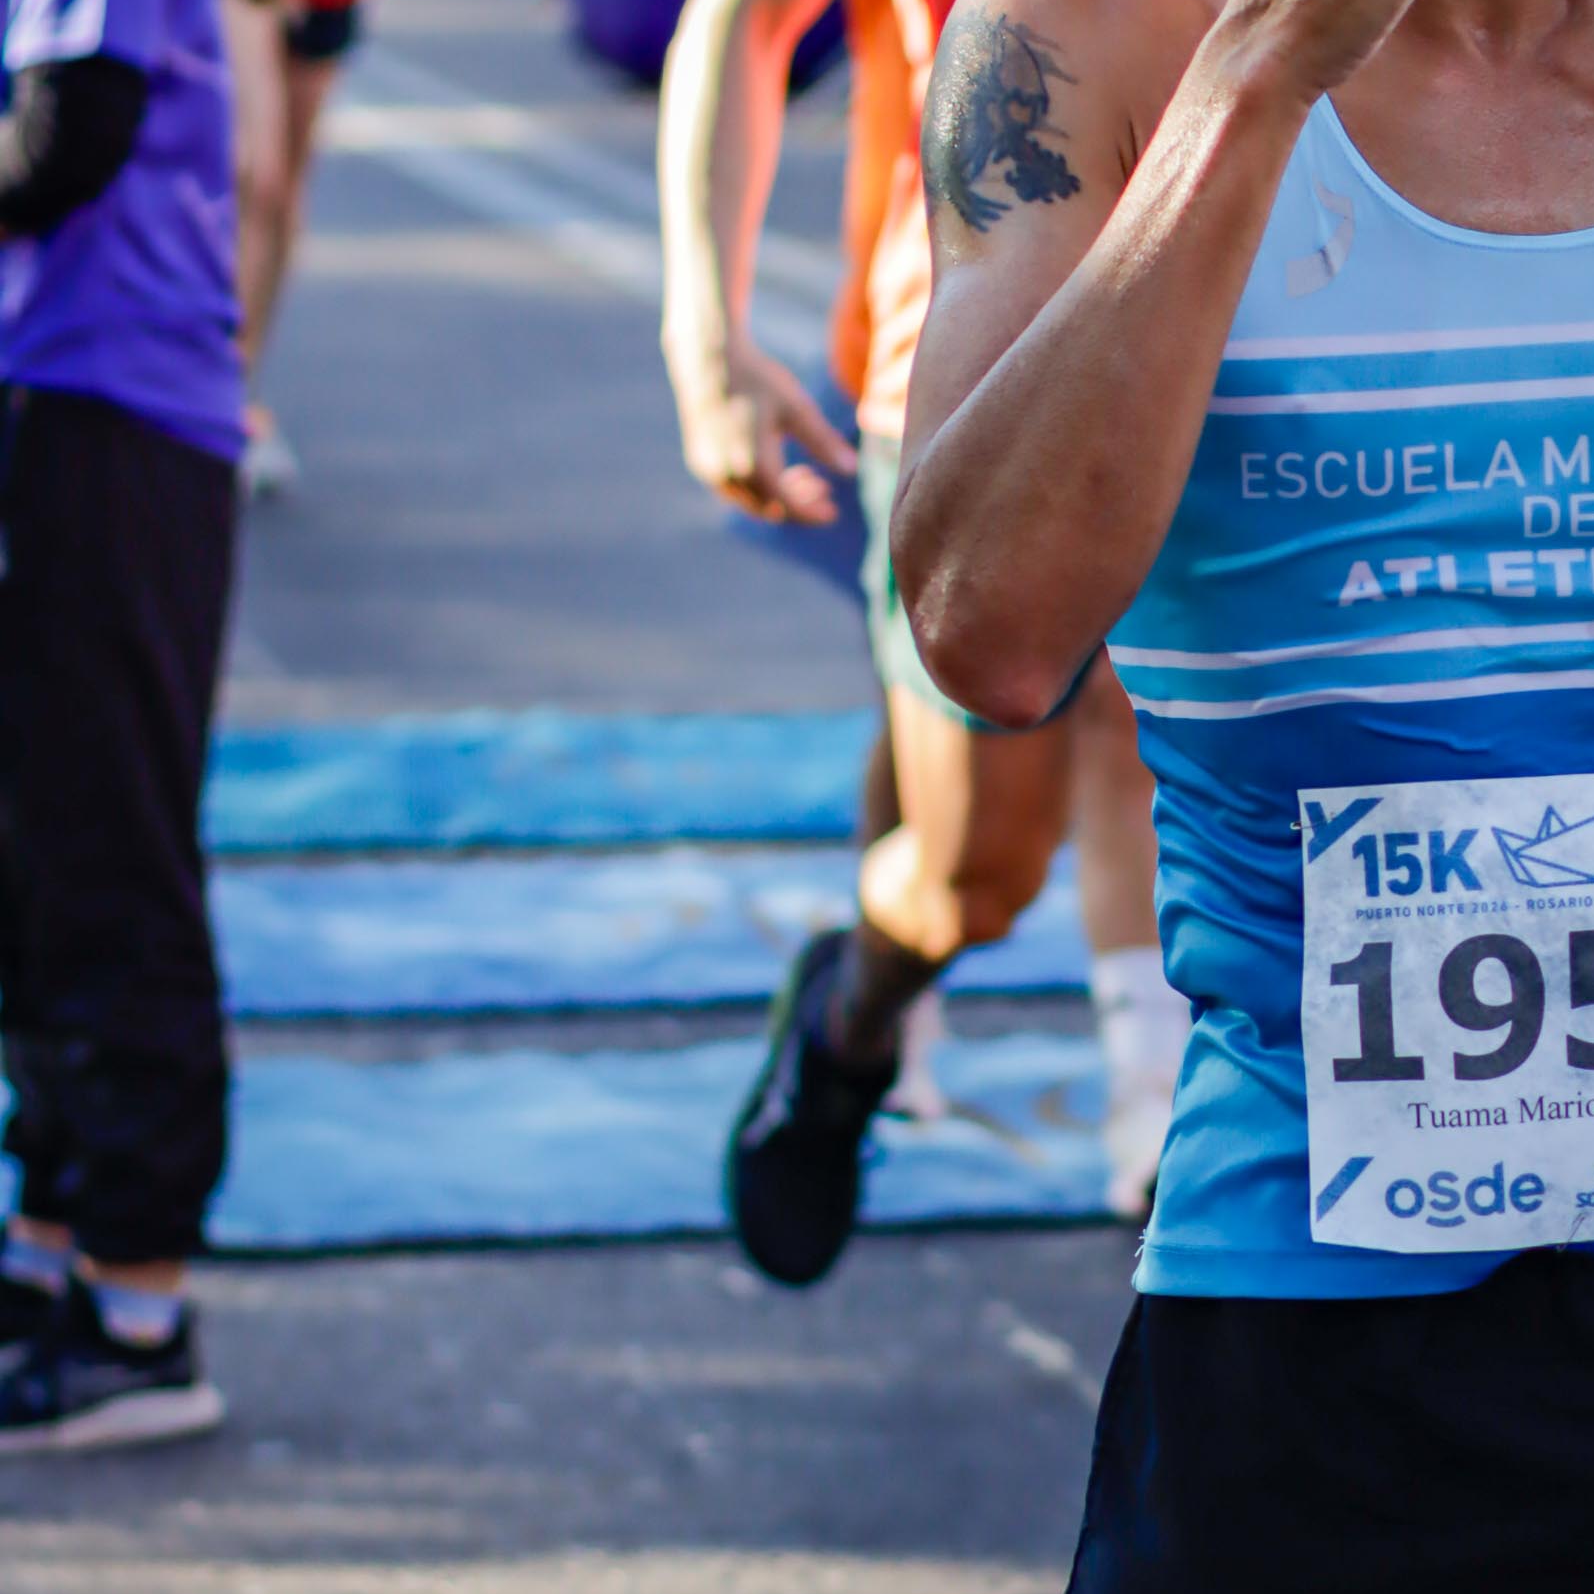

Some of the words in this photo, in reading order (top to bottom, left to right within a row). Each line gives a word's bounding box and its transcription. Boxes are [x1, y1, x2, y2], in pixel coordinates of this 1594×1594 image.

[1240, 442, 1525, 499] ESCUELA
[1352, 828, 1483, 898] 15K
[1356, 907, 1411, 920] PUERTO
[1417, 903, 1465, 917] NORTE
[1526, 896, 1593, 910] ROSARIO
[1408, 1102, 1508, 1129] Tuama
[1385, 1161, 1545, 1219] osde
